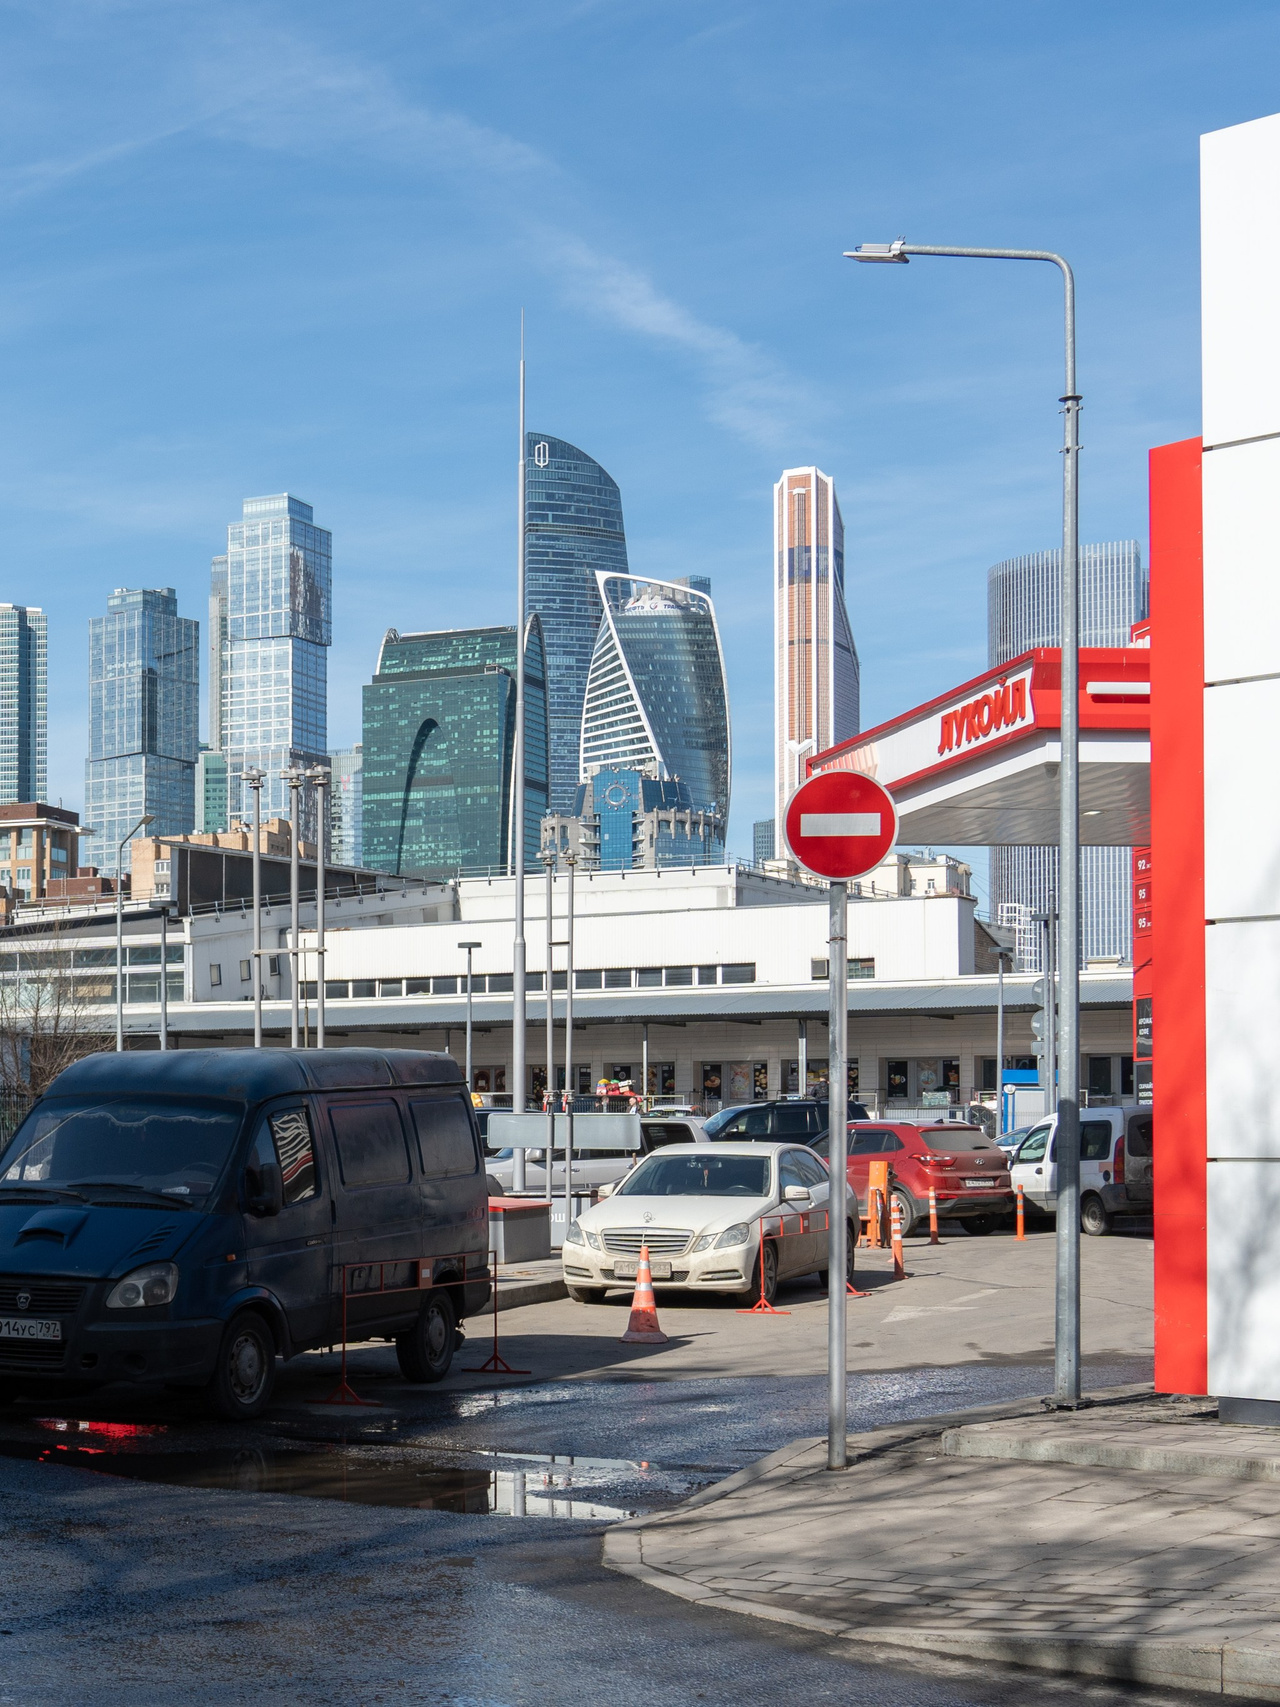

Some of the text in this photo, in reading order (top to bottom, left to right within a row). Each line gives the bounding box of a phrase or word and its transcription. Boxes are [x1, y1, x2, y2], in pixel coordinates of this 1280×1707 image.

[938, 677, 1026, 755] ЛУКОЙЛ
[1138, 888, 1146, 899] 95
[1138, 917, 1146, 928] 95
[38, 1322, 57, 1333] 797
